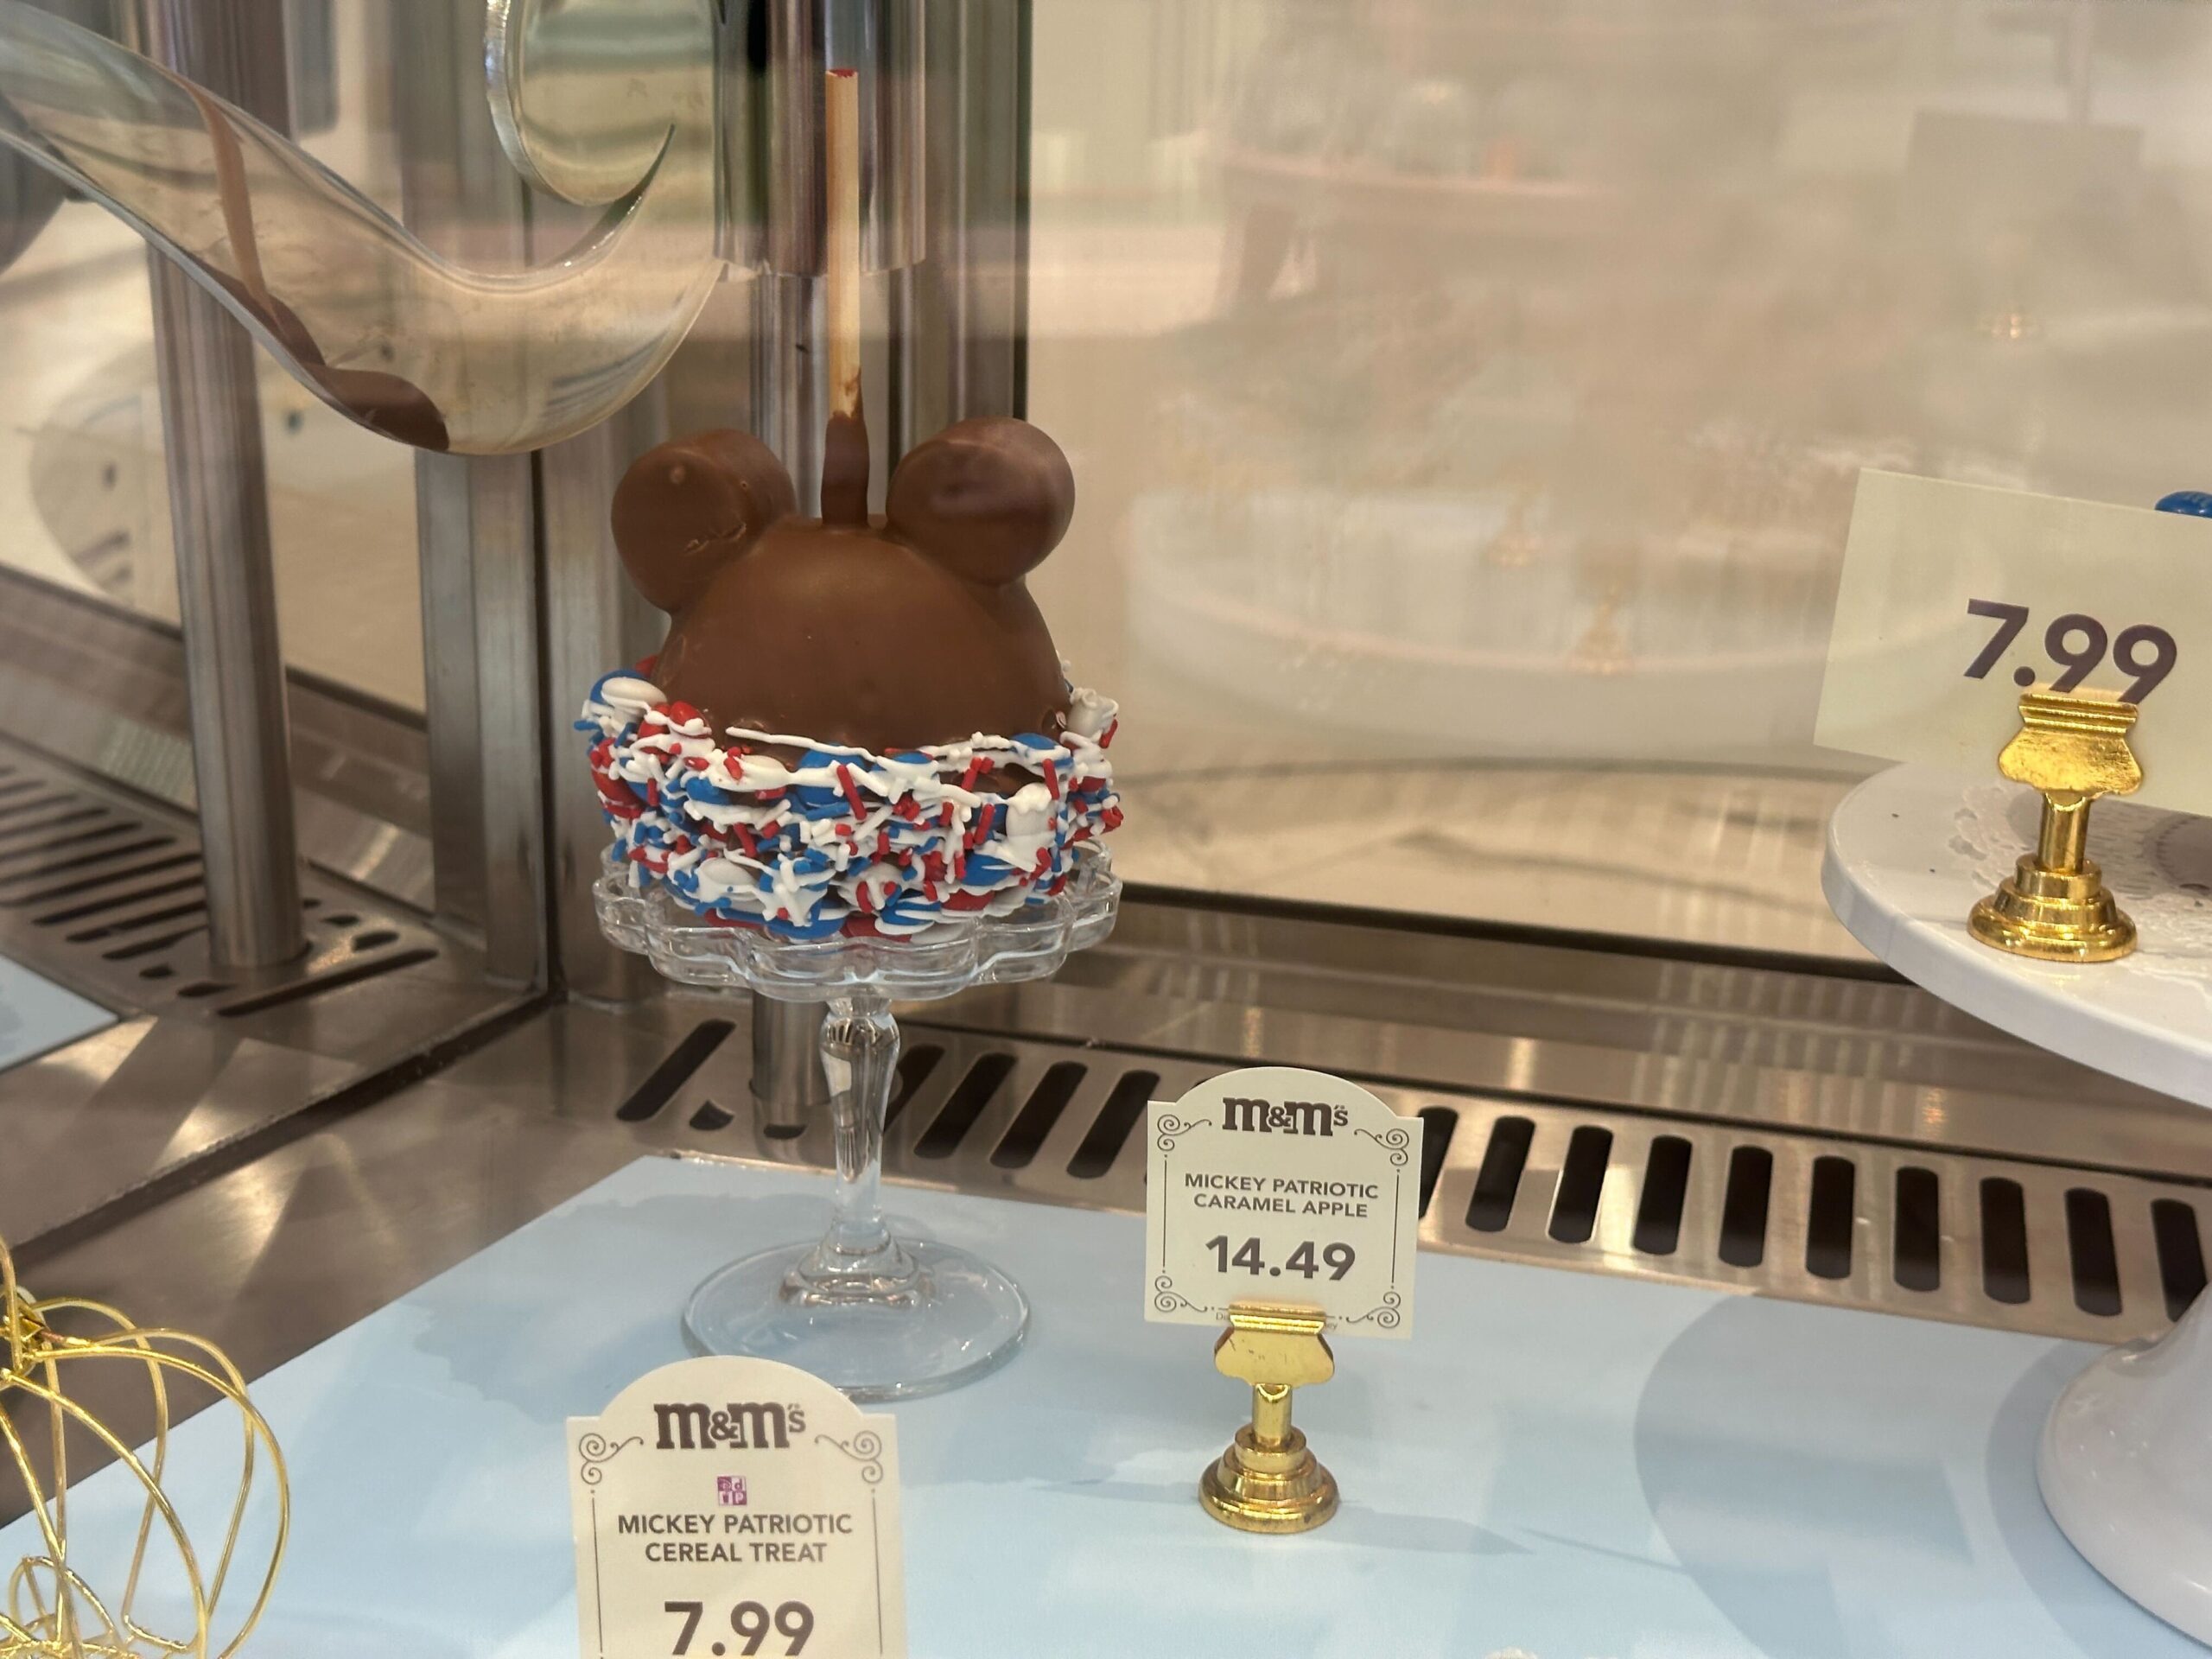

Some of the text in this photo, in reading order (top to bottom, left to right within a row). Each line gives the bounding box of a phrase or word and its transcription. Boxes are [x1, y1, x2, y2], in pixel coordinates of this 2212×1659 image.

[1964, 598, 2177, 705] 7.99
[1185, 1173, 1379, 1199] MICKEY PATRIOTIC
[1194, 1193, 1368, 1218] CARAMEL APPLE
[1205, 1235, 1357, 1281] 14.49
[618, 1514, 853, 1535] MICKEY PATRIOTIC
[645, 1541, 828, 1563] CEREAL TREAT
[664, 1600, 815, 1656] 7.99
